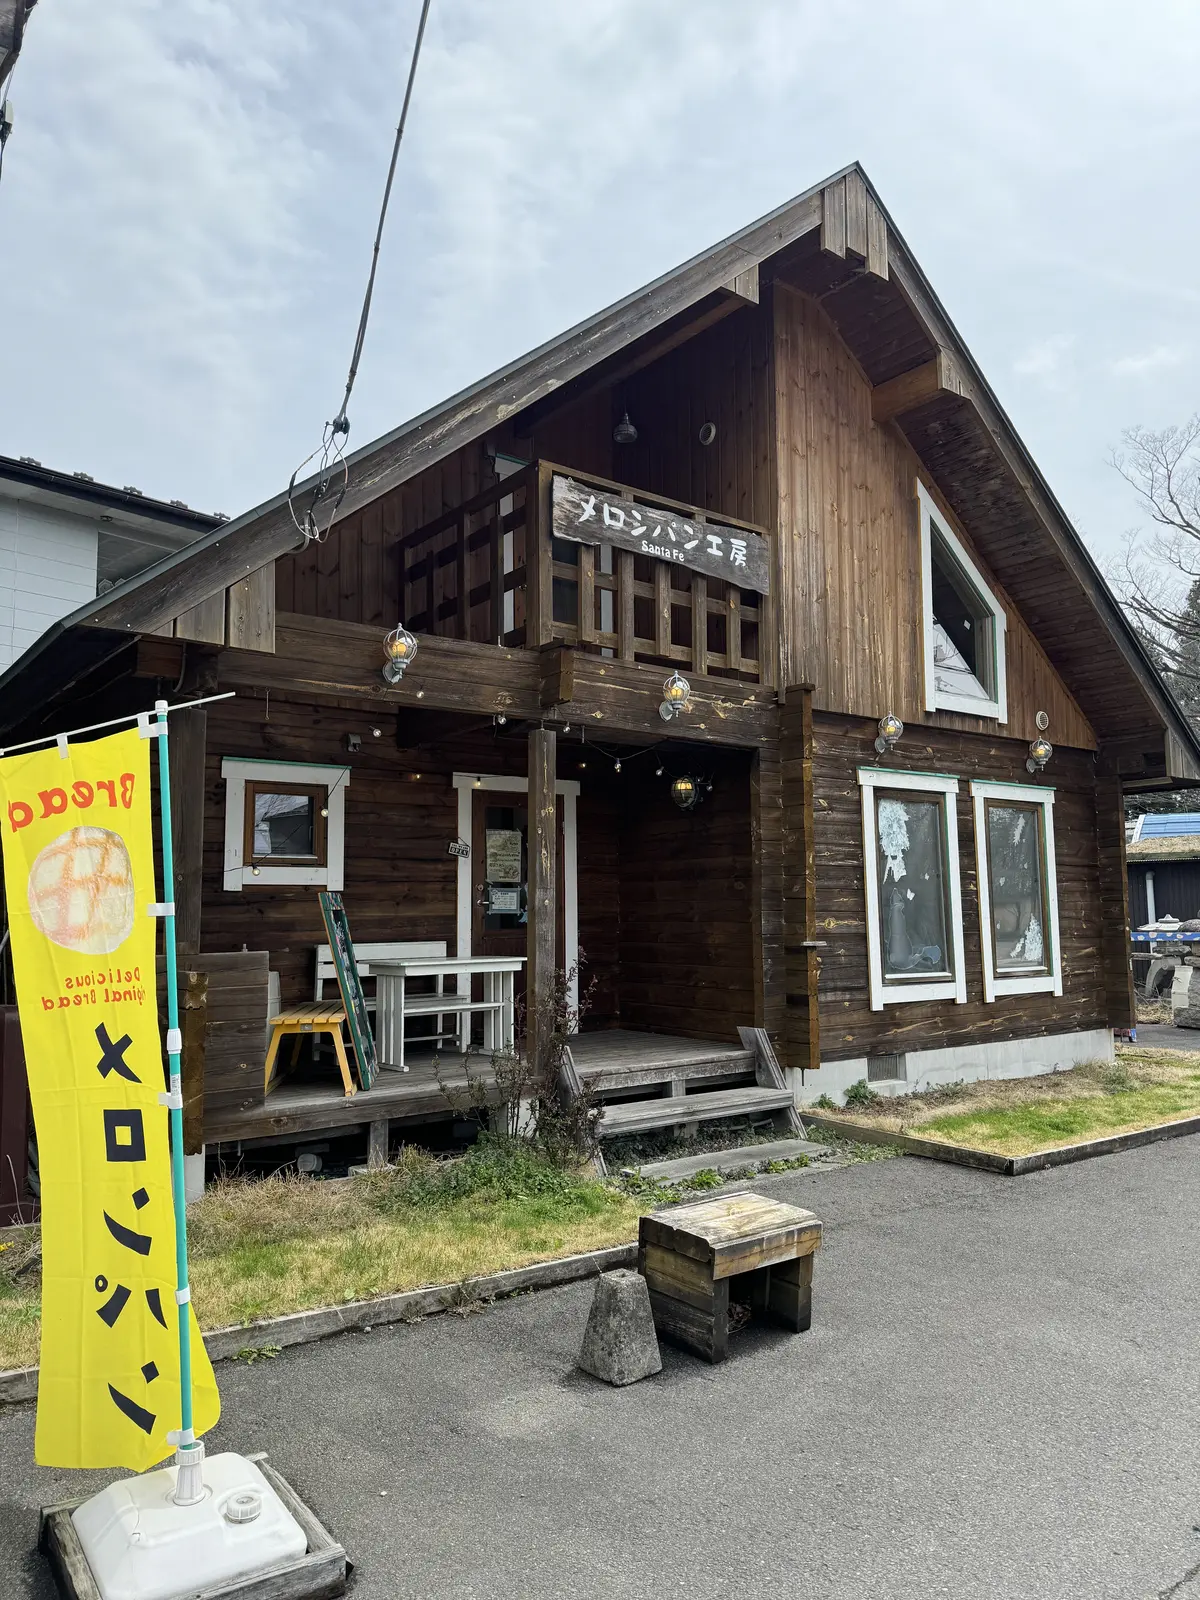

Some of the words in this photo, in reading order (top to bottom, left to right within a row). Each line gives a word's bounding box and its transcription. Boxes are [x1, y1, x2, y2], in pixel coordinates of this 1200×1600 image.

[577, 495, 747, 567] メロンパン工房
[641, 540, 671, 557] Santa
[672, 549, 686, 563] Fe
